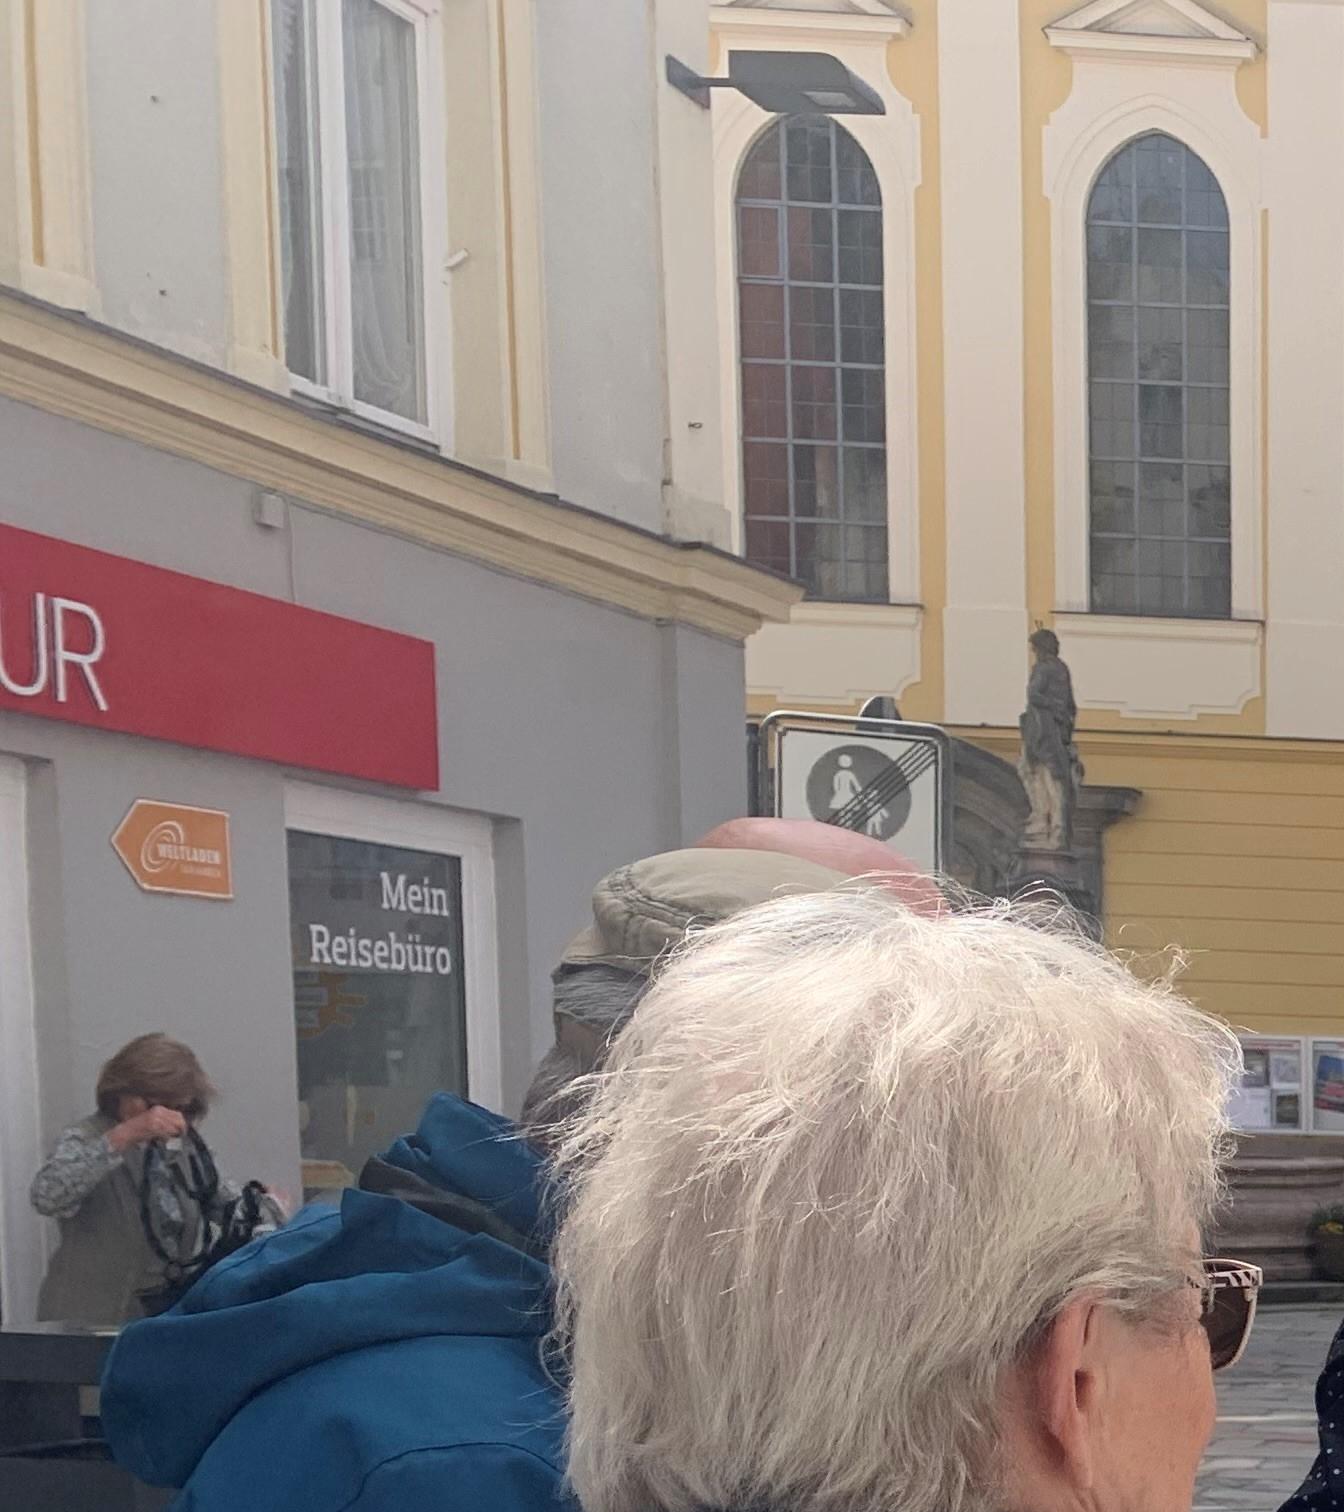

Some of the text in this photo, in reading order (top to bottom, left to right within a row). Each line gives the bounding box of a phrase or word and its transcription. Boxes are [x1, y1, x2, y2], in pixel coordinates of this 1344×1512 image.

[157, 843, 221, 864] WELTLADEN
[380, 872, 449, 916] Mein
[309, 923, 452, 975] Reisebüro
